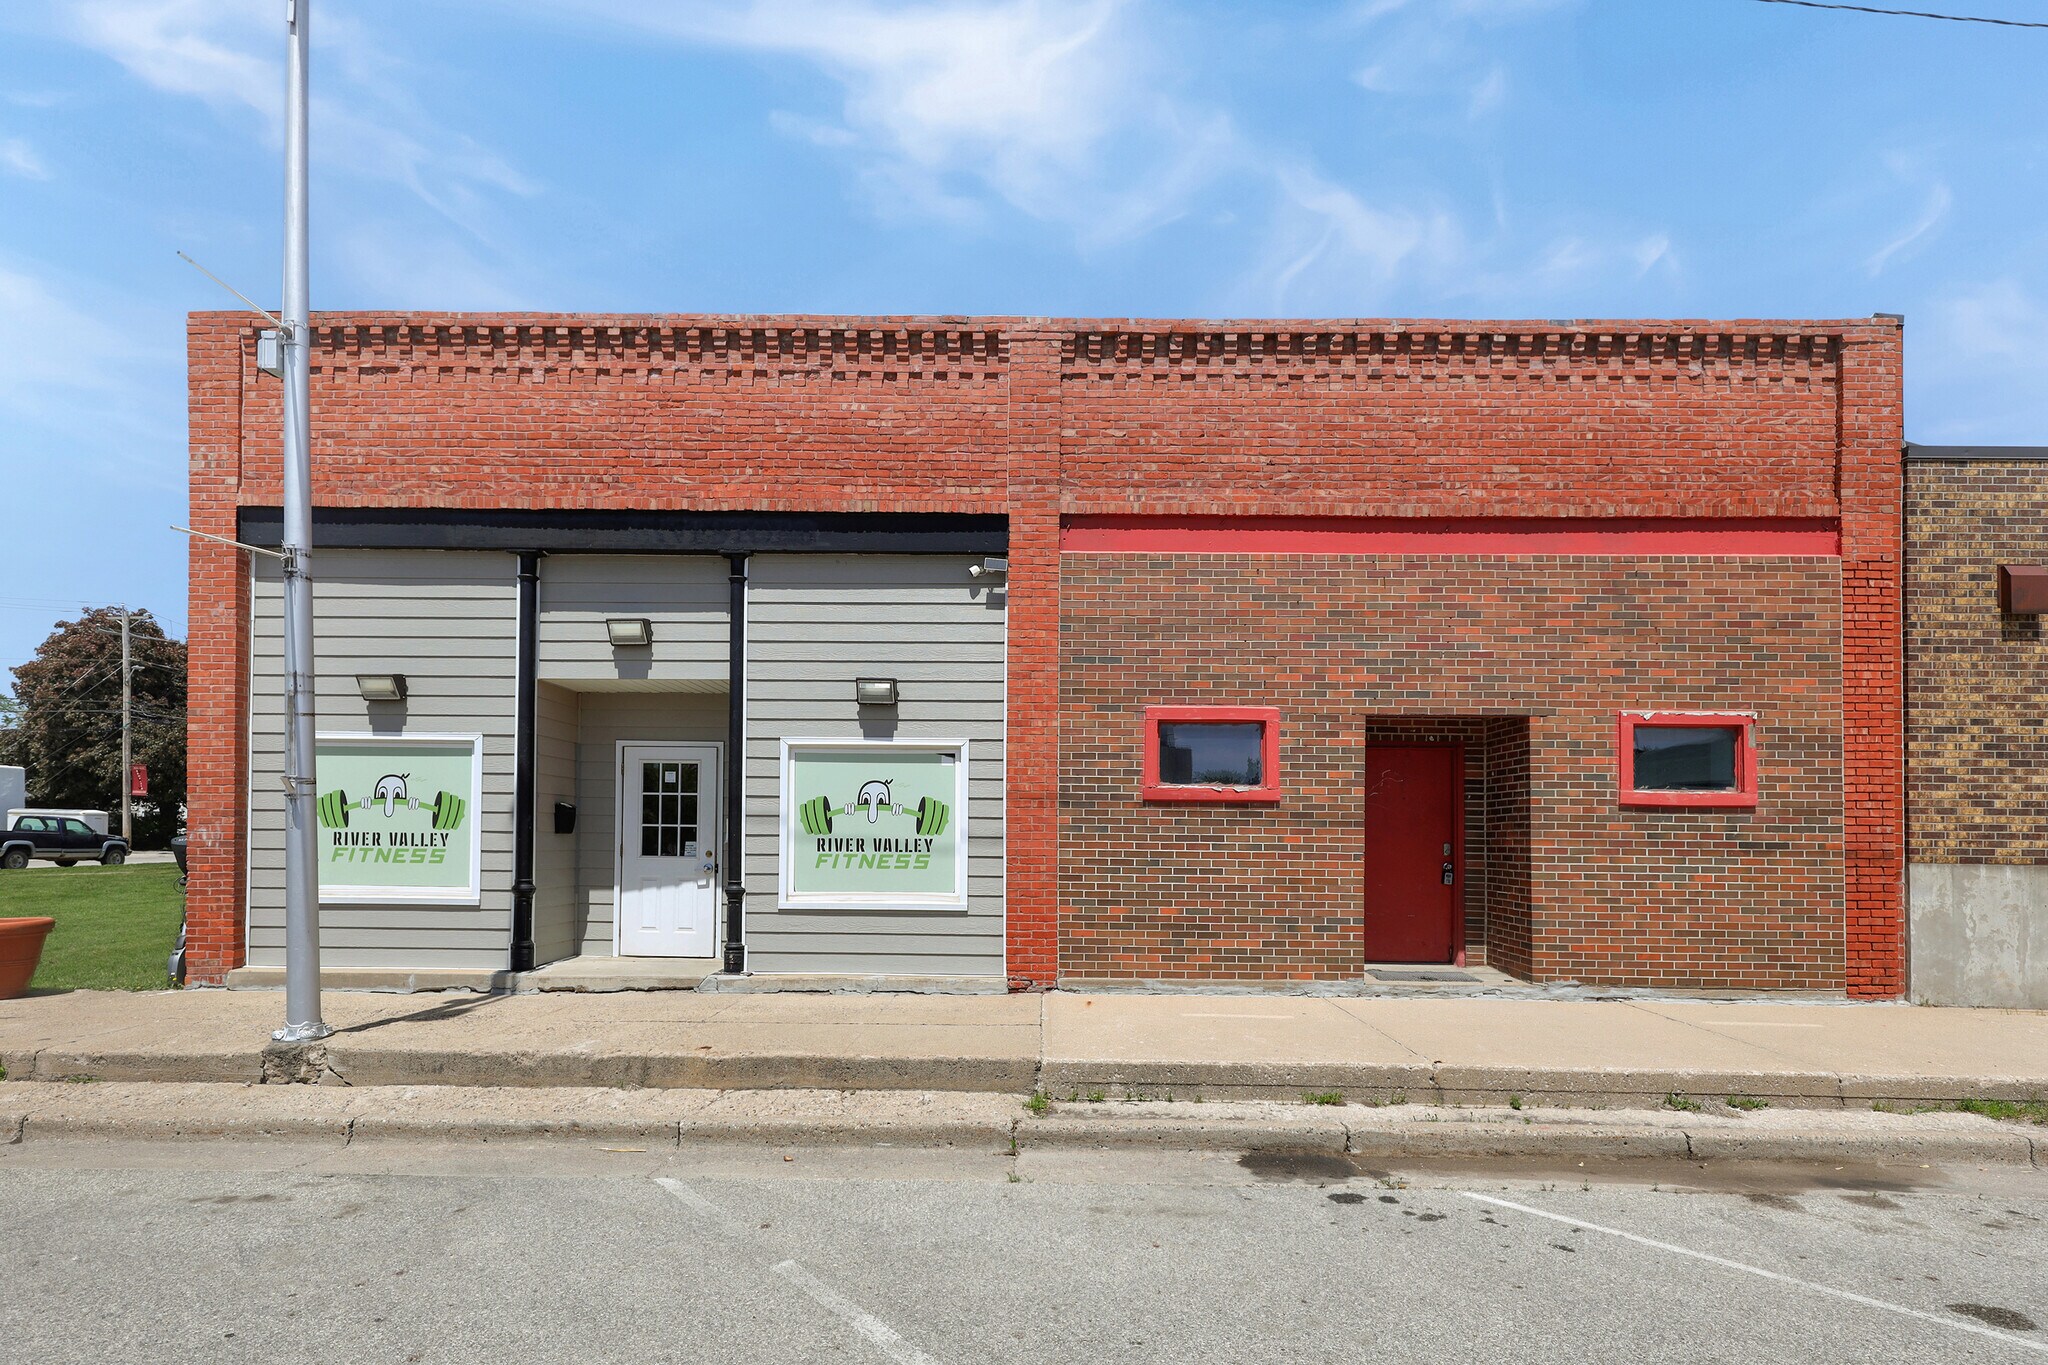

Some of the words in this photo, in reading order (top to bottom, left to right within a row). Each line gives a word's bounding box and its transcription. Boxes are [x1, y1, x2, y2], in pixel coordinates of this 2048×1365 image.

[333, 831, 381, 847] RIVER
[389, 831, 449, 847] VALLEY
[816, 837, 865, 853] RIVER
[873, 837, 934, 853] VALLEY
[331, 847, 446, 864] FITNESS
[815, 853, 931, 870] FITNESS
